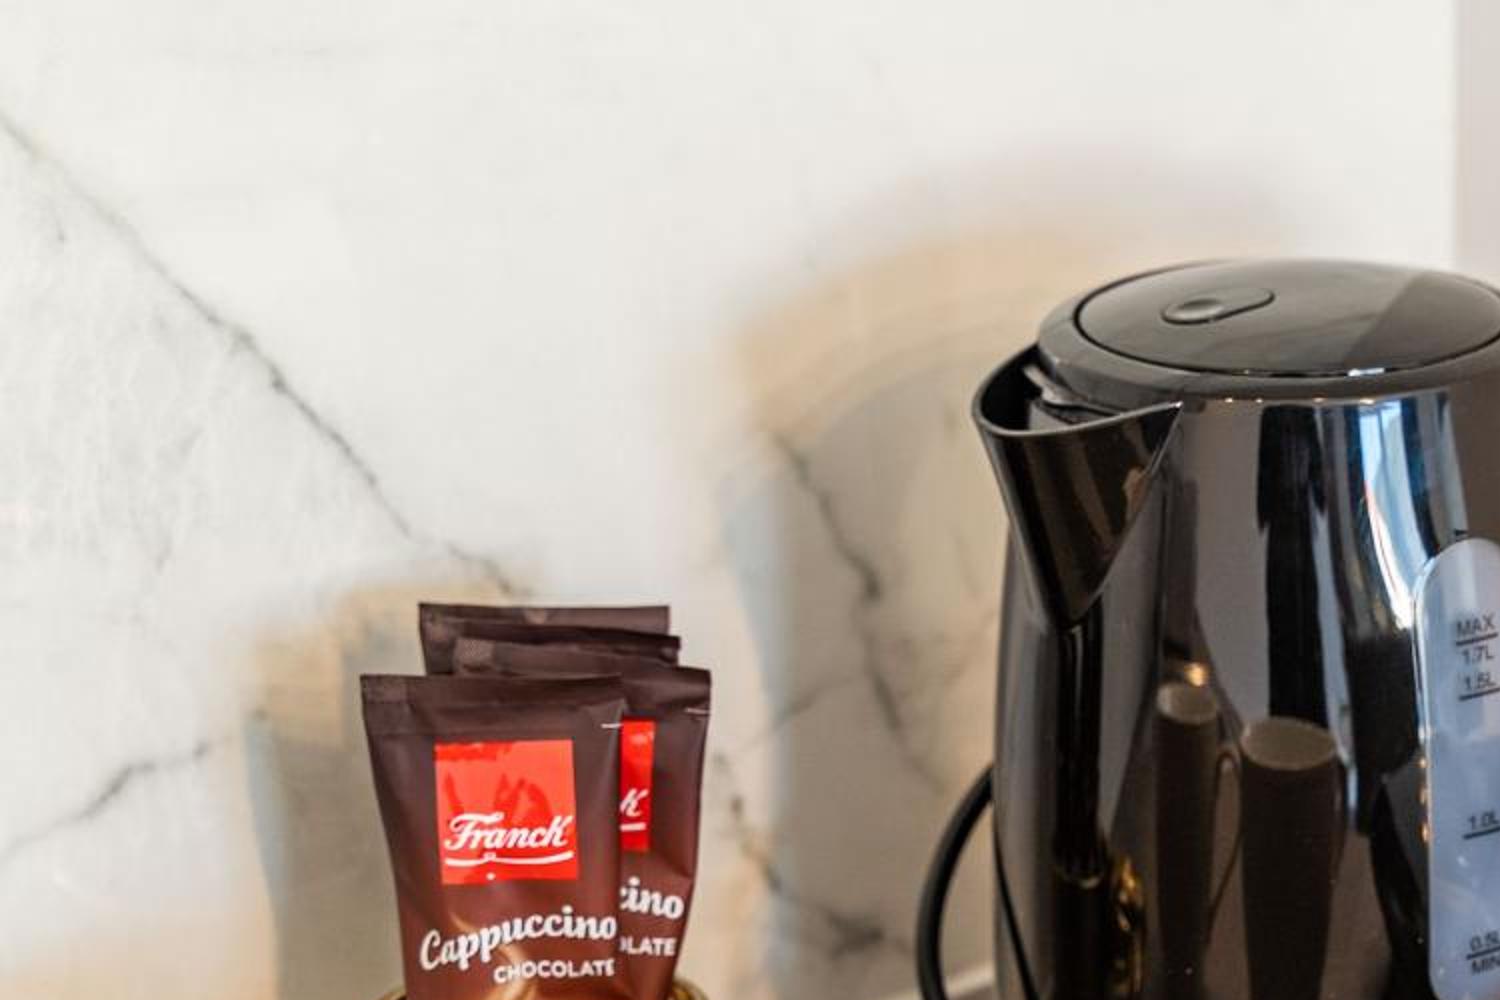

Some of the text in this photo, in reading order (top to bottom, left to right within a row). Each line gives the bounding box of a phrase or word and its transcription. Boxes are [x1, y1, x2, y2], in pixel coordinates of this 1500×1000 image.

[1456, 613, 1495, 636] MAX
[444, 812, 574, 851] Franck
[419, 904, 618, 971] Cappuccino
[493, 958, 616, 984] CHOCOLATE
